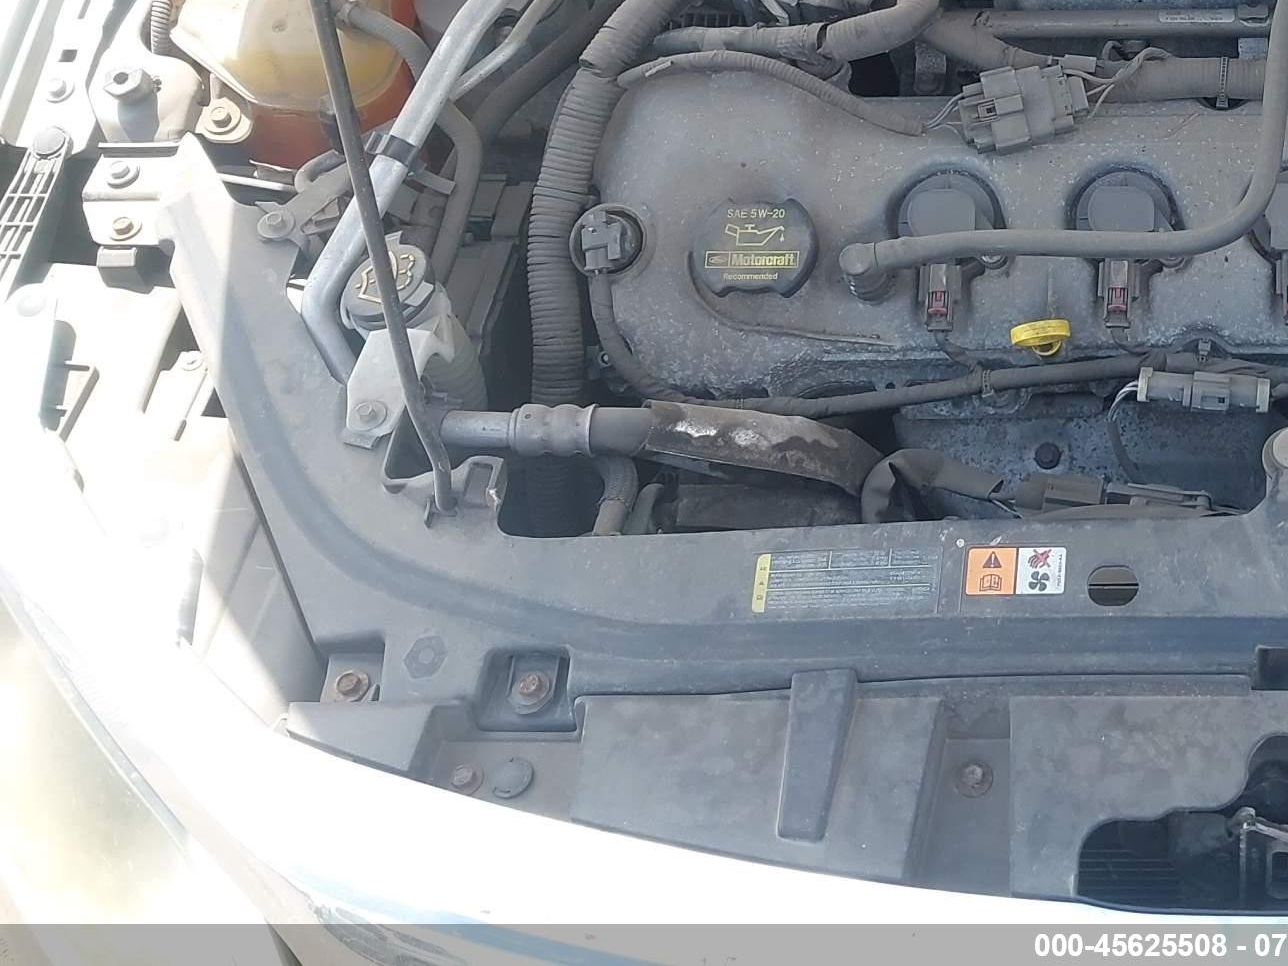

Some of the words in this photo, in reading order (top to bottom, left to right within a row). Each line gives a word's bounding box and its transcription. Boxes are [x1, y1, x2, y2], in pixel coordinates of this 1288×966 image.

[727, 208, 748, 219] SAE
[750, 208, 786, 219] 5W-20
[731, 253, 796, 267] Motorcraft
[723, 272, 778, 281] Recommended
